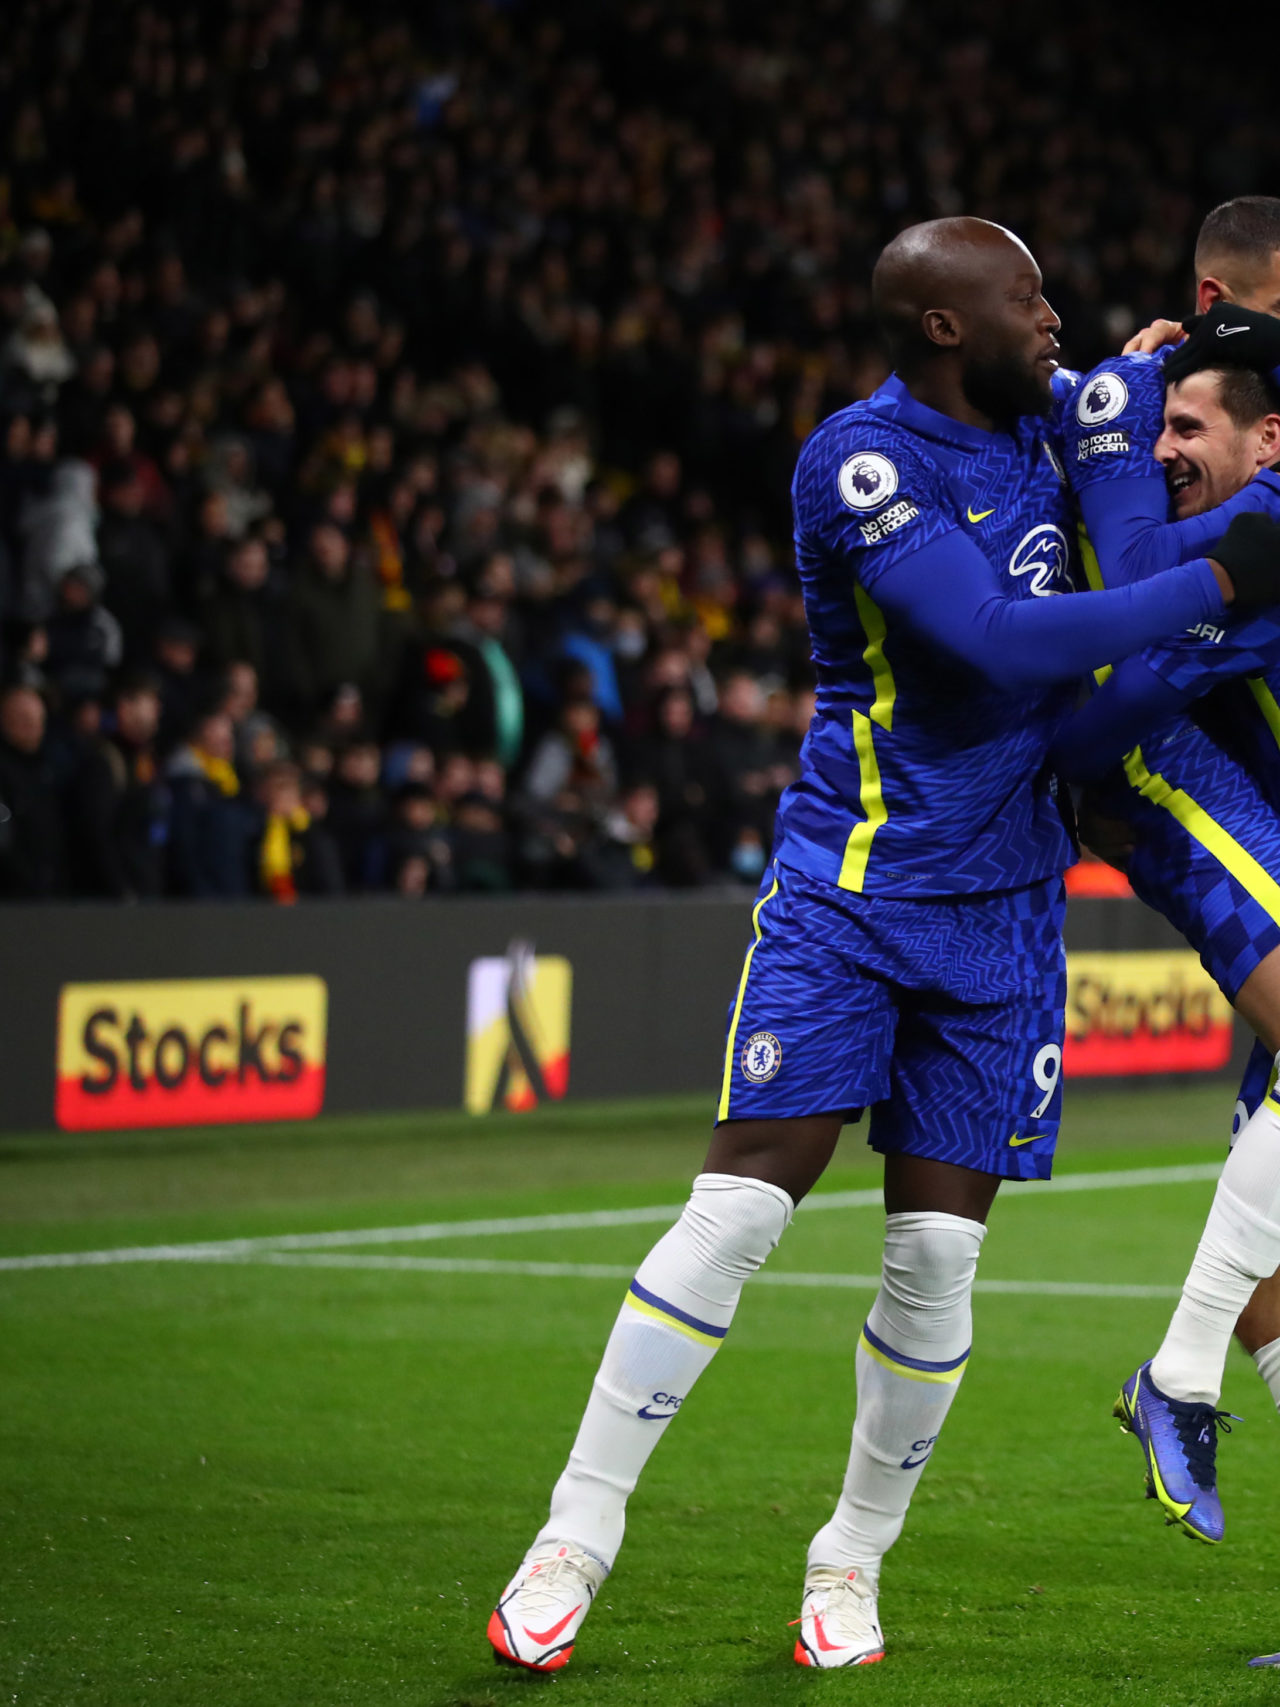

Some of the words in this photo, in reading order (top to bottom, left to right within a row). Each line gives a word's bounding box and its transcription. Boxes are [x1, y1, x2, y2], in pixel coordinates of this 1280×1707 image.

[1090, 432, 1122, 445] room
[1090, 442, 1129, 455] racism
[859, 521, 878, 535] No
[876, 501, 909, 526] room
[881, 507, 920, 535] racism
[81, 998, 304, 1095] Stocks
[1030, 1043, 1062, 1118] 9
[912, 1435, 938, 1451] CF
